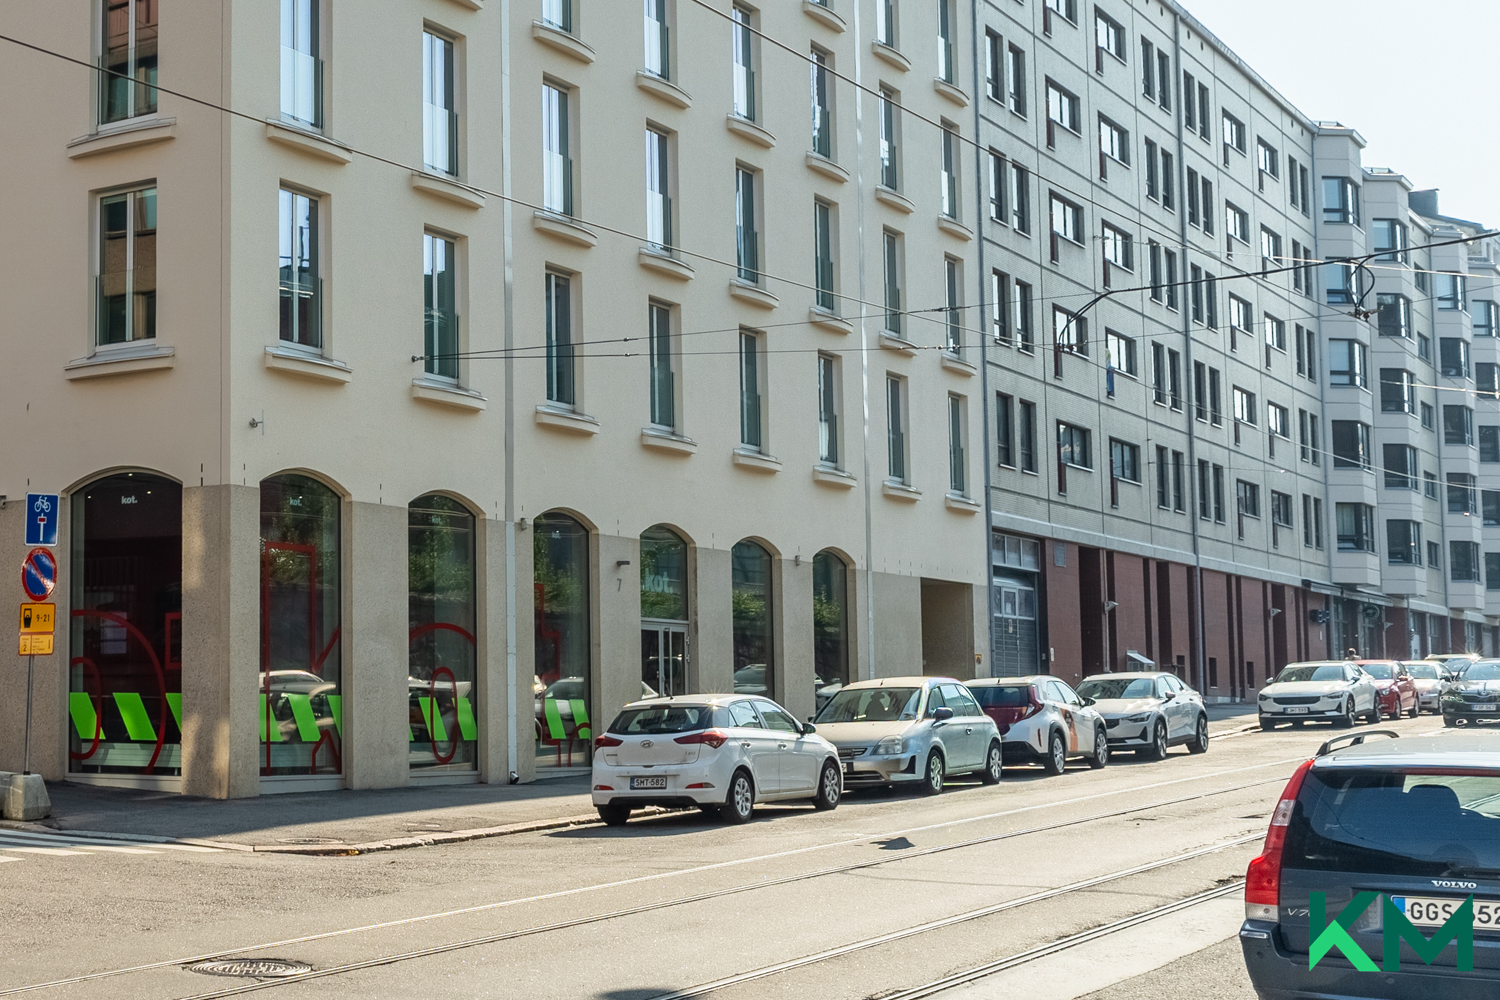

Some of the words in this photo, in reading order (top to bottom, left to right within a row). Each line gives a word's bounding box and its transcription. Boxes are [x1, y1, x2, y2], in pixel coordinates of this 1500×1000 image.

[121, 495, 138, 505] kot.
[616, 577, 622, 592] 7
[644, 567, 674, 594] kot.
[35, 613, 50, 622] 9-21
[635, 778, 666, 787] SMT-582
[1431, 880, 1477, 890] VOLVO
[1287, 907, 1310, 918] V7
